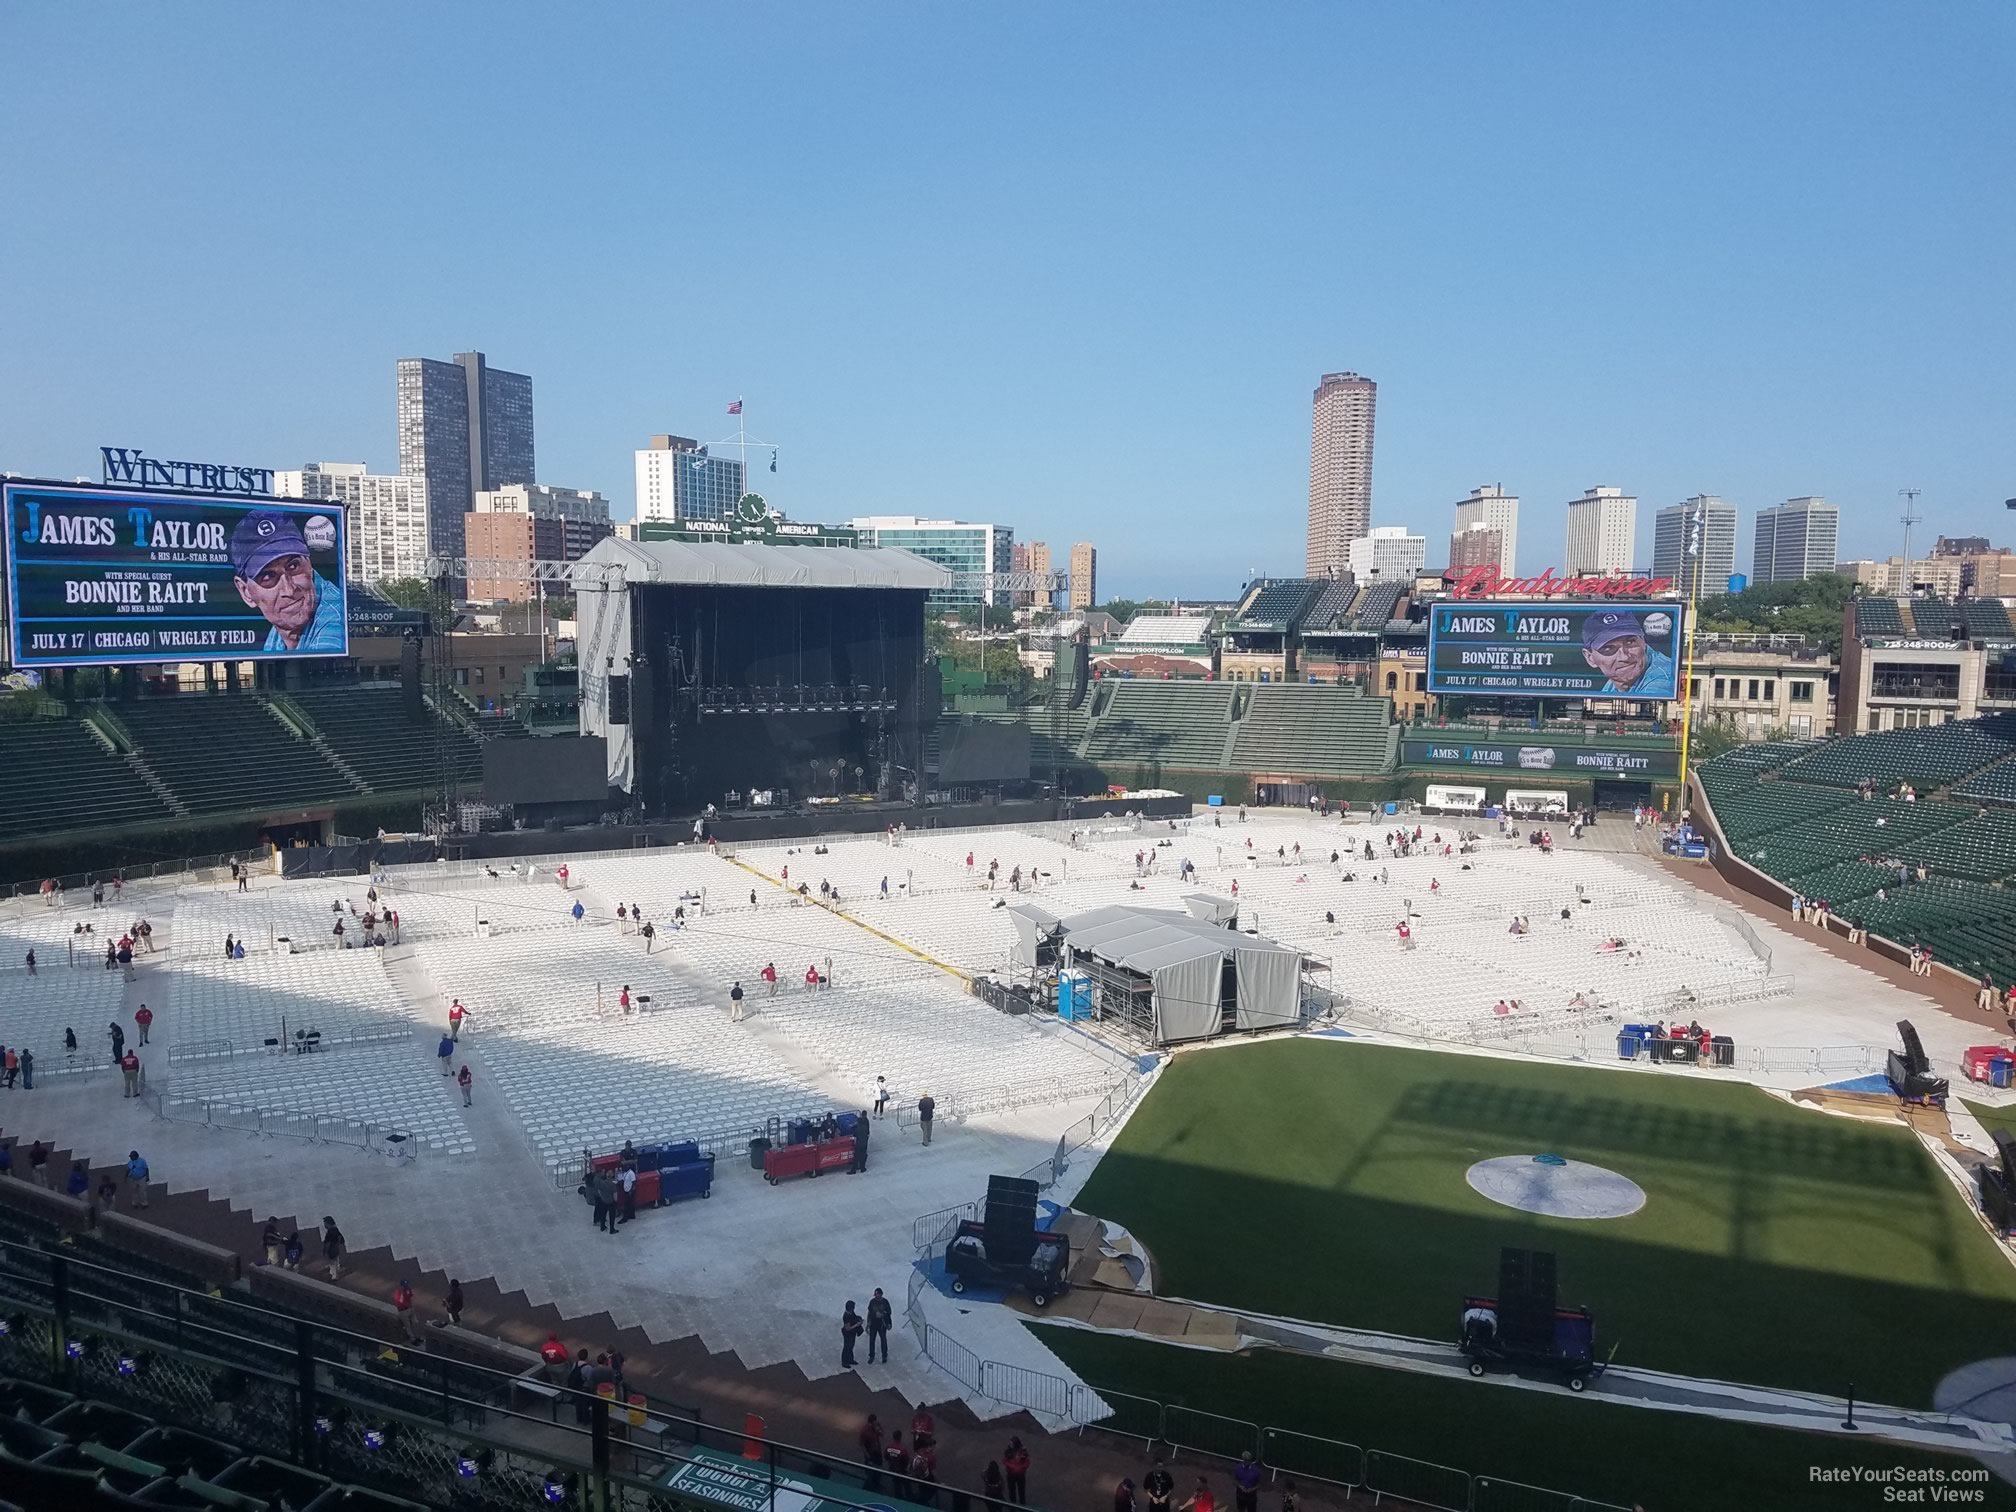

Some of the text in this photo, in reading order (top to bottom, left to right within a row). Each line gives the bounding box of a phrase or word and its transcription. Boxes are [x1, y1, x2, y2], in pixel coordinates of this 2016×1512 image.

[100, 446, 275, 493] WINTRUST
[22, 502, 227, 550] JAMES TAYLOR
[685, 521, 731, 532] NATIONAL
[775, 525, 819, 535] AMERICAN
[150, 552, 228, 562] & HIS ALL-STAR BAND
[105, 571, 123, 579] WITH
[124, 572, 150, 580] SPECIAL
[1442, 564, 1674, 599] Budweiser
[65, 581, 208, 604] BONNIE RAITT
[131, 605, 145, 613] HER
[146, 605, 164, 613] BAND
[1440, 611, 1570, 634] JAMES TAYLOR
[31, 630, 256, 649] JULY 17 CHICAGO WRIGLEY FIELD
[1462, 651, 1554, 665] BONNIE RAITT
[1446, 676, 1592, 688] JULY 17 CHICAGO WRIGLEY FIELD
[1426, 744, 1503, 761] JAMES TAYLOR
[1576, 755, 1614, 767] BONNIE
[1616, 757, 1649, 768] RAITT
[674, 1479, 763, 1511] SEASONINGS
